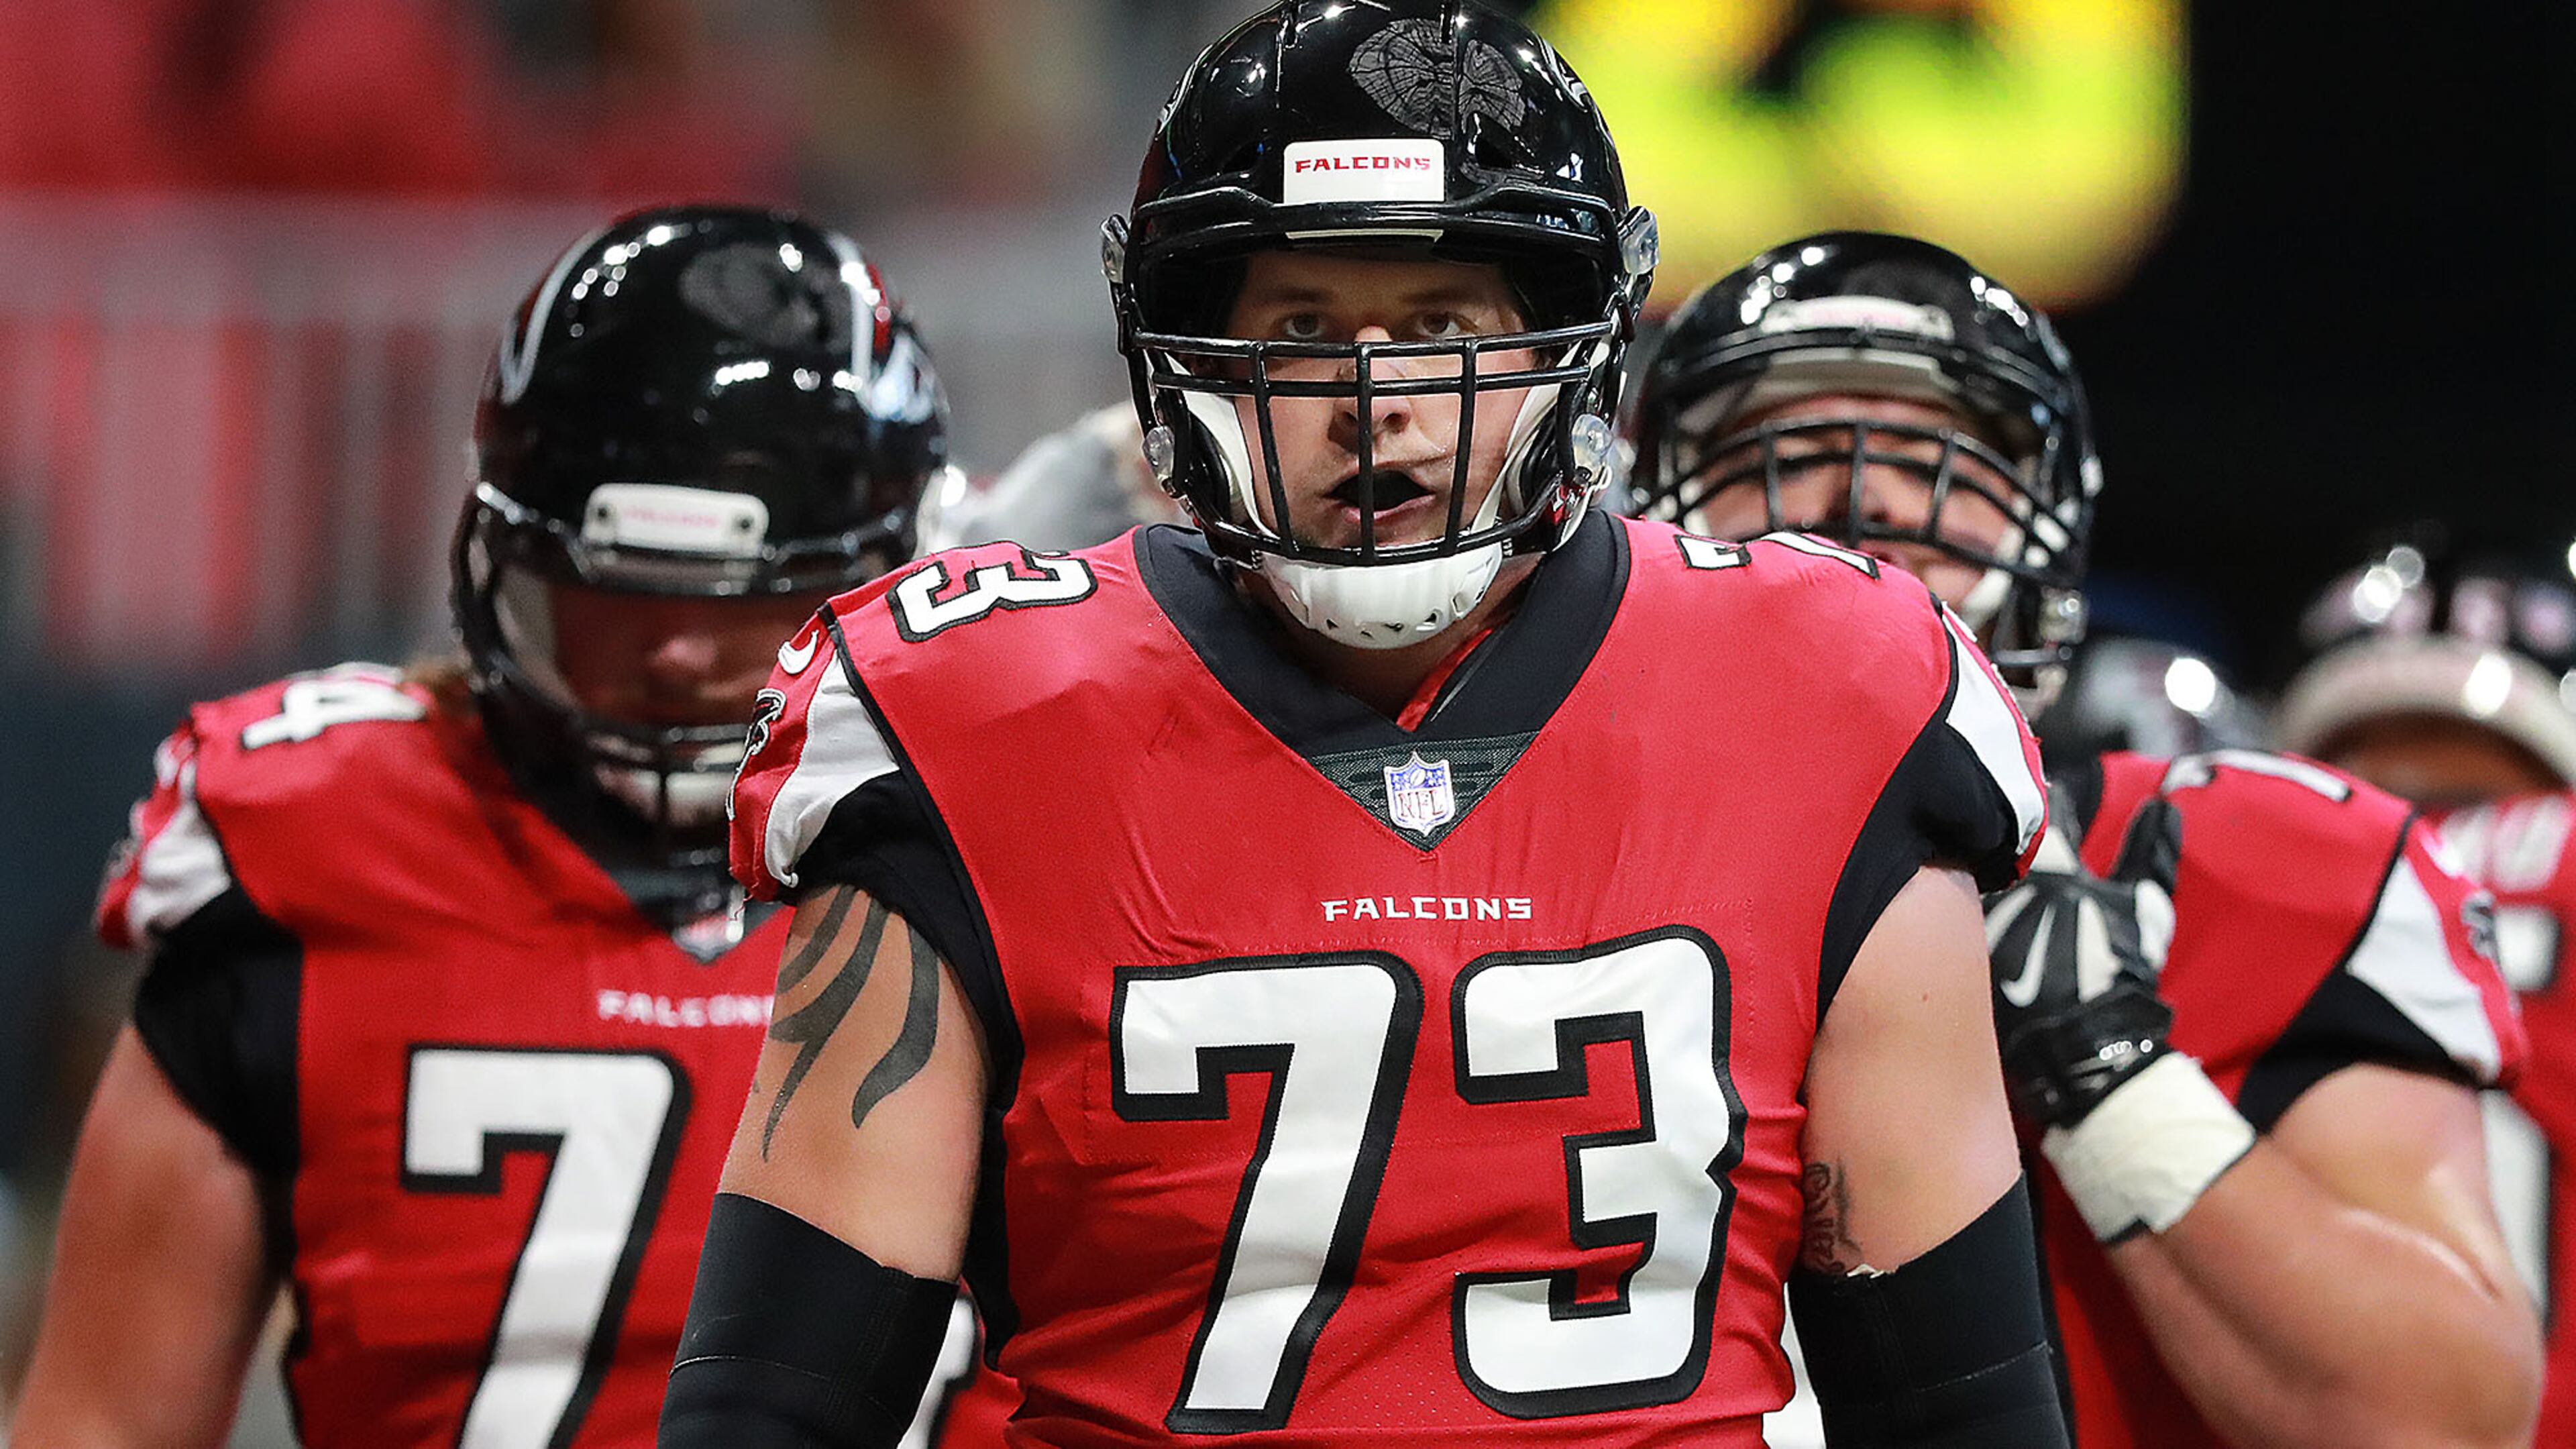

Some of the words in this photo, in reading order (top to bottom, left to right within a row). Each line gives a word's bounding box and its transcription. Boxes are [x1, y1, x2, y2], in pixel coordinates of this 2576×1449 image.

[1295, 156, 1431, 173] FALCONS
[1398, 791, 1444, 819] NFL
[1321, 896, 1533, 922] FALCONS
[1110, 924, 1748, 1435] 73
